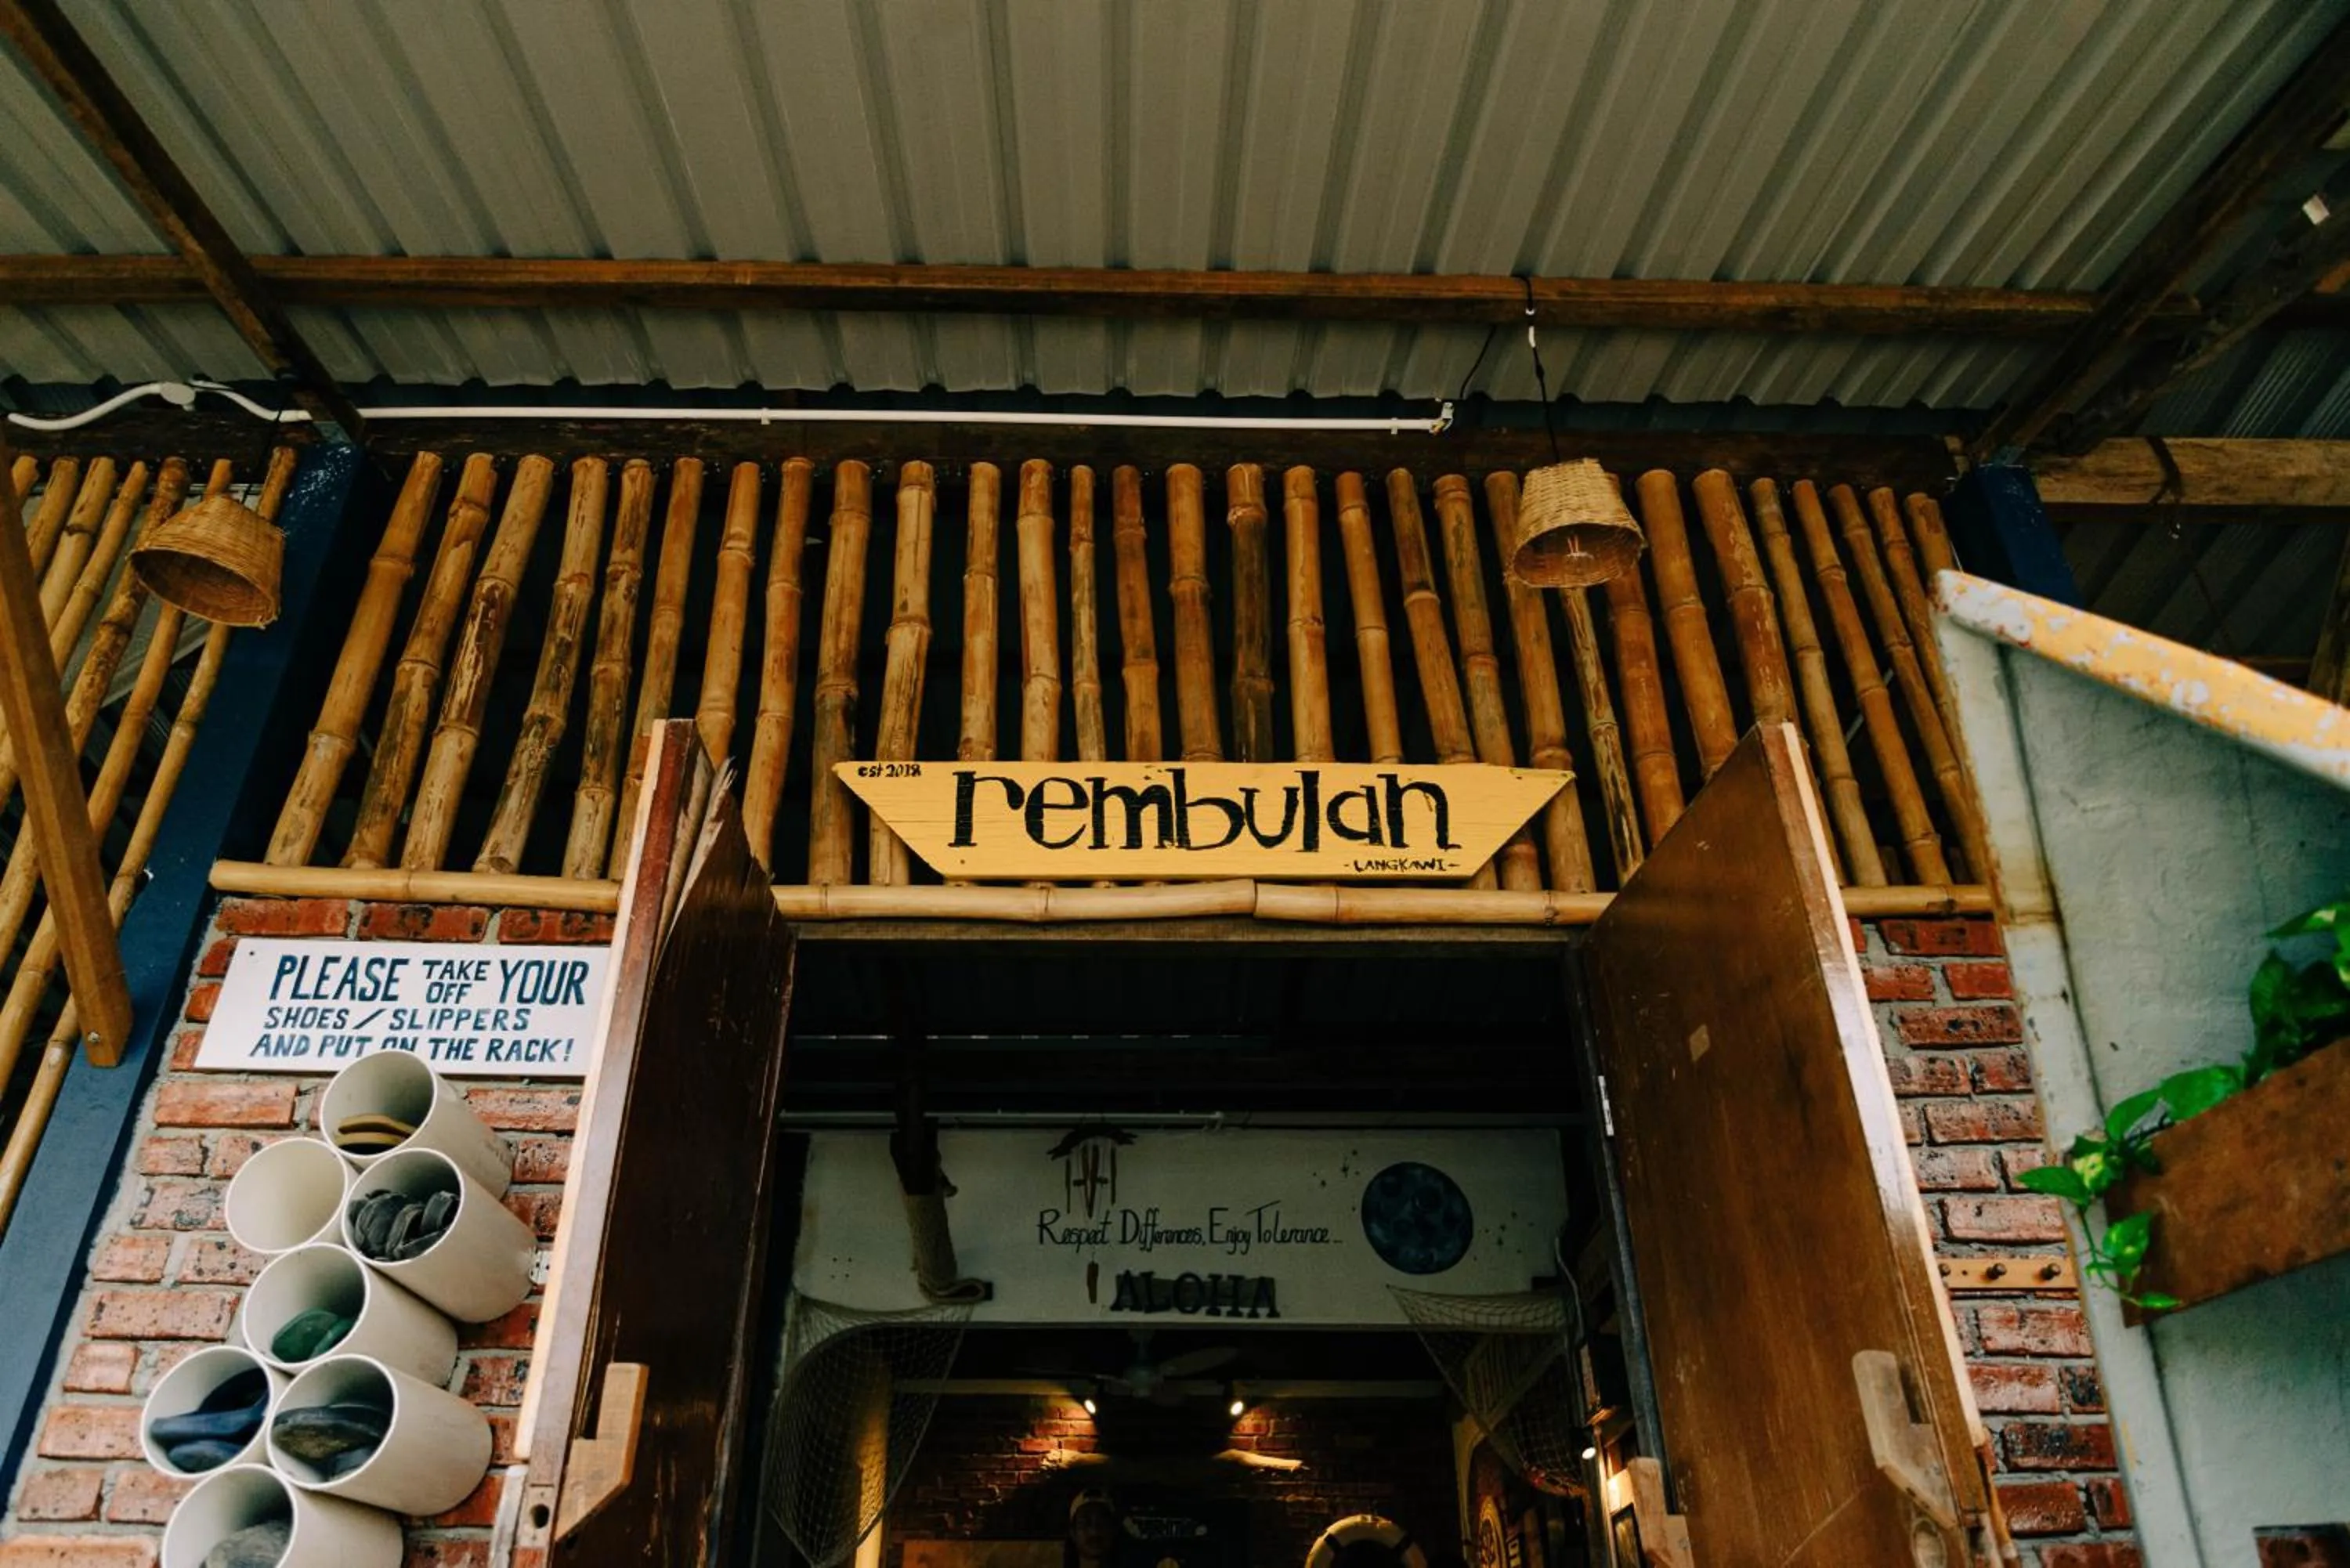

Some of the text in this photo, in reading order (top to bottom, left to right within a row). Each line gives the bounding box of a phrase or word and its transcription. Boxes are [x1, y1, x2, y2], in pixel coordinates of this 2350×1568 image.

[948, 768, 1461, 852] rembulan
[269, 955, 589, 1005] PLEASE TAKE OFF YOUR
[250, 1032, 310, 1057] AND
[317, 1034, 374, 1058] PUT
[428, 1037, 478, 1061] THE
[485, 1039, 574, 1063] RACK!
[1036, 1209, 1111, 1252] Respect
[1209, 1207, 1251, 1254] Enjoy
[1110, 1270, 1281, 1318] ALOHA
